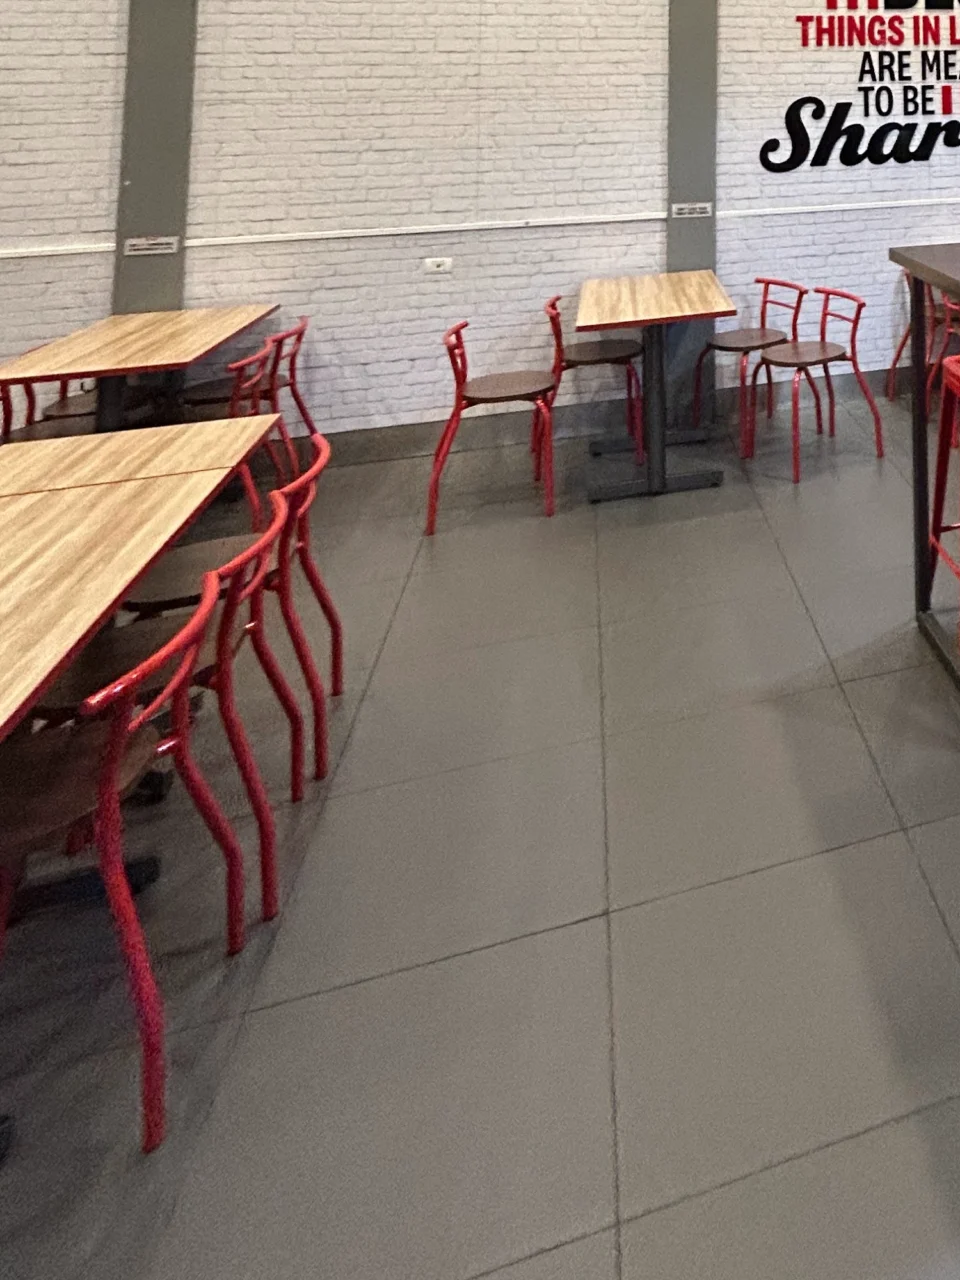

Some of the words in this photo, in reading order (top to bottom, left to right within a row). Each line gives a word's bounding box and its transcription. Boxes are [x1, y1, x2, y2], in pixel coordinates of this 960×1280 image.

[796, 15, 905, 47] THINGS
[913, 15, 941, 47] IN
[858, 51, 912, 82] ARE
[858, 86, 893, 117] TO
[903, 85, 935, 115] BE
